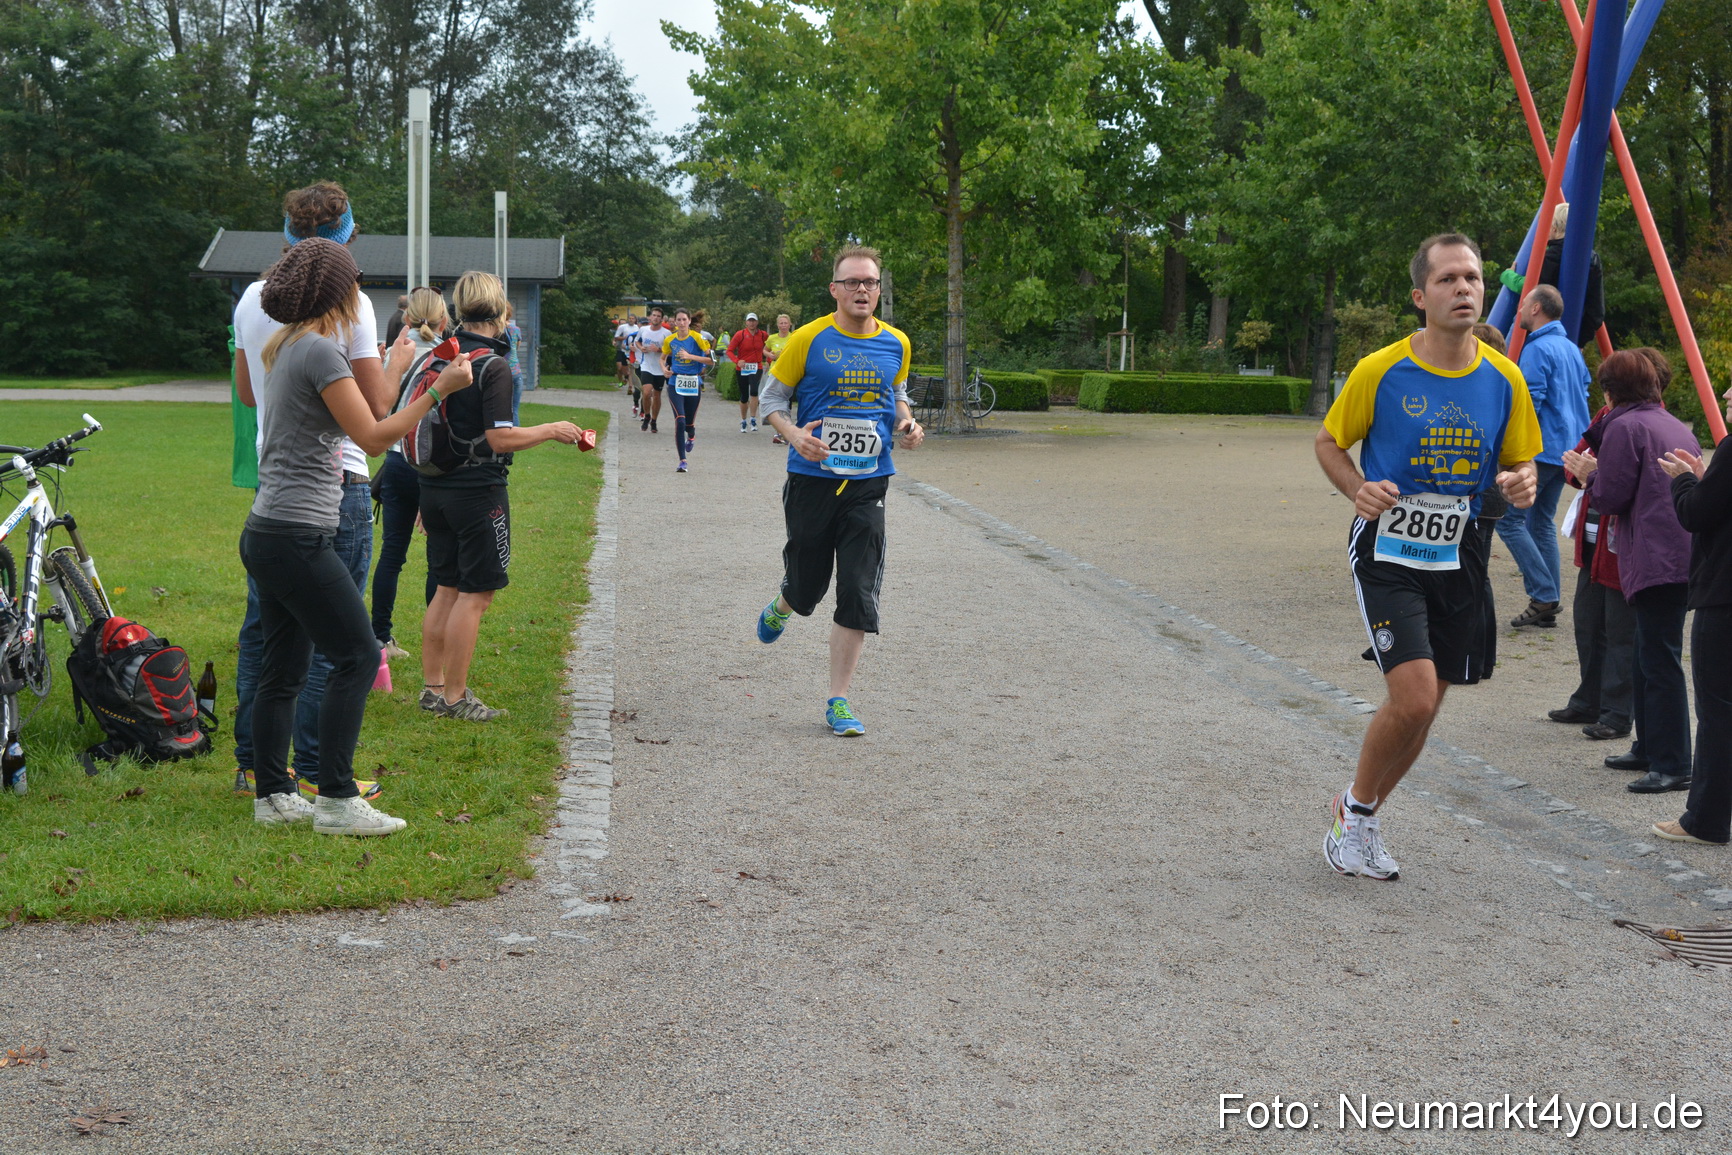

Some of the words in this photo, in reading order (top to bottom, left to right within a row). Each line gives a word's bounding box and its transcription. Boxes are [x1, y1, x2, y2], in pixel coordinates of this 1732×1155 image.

[678, 380, 697, 388] 2480
[824, 421, 845, 430] PARTL
[828, 431, 878, 454] 2357
[833, 457, 869, 467] Christian
[1416, 499, 1456, 510] Neumarkt
[4, 505, 26, 529] STING
[1388, 506, 1461, 542] 2869
[1400, 544, 1438, 560] Martin
